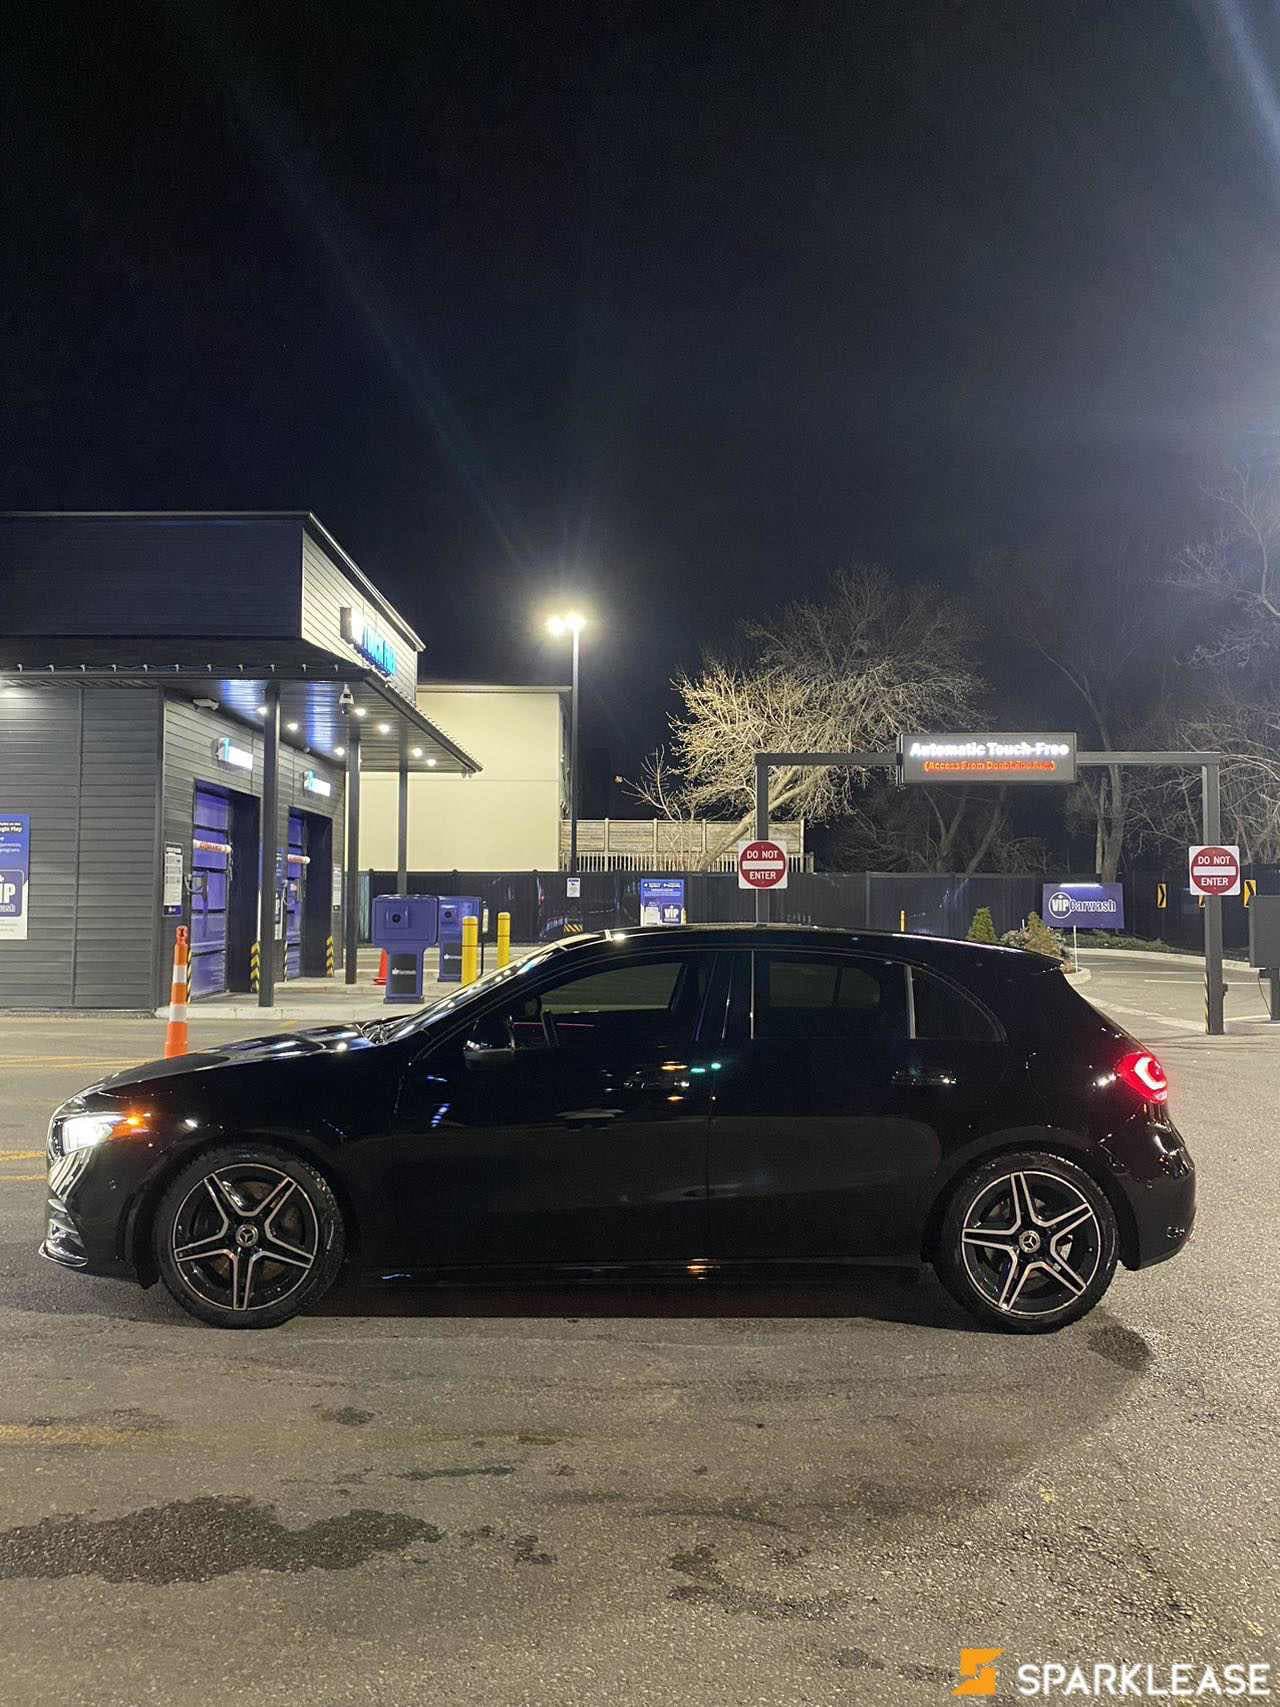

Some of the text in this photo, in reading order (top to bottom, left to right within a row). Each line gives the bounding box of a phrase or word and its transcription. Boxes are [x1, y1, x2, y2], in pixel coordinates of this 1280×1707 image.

[910, 742, 1069, 757] Automatic Touch-Free
[746, 850, 779, 859] DO NOT
[1197, 855, 1230, 865] DO NOT
[749, 871, 776, 880] ENTER
[1201, 877, 1229, 886] ENTER
[1051, 898, 1117, 913] VIP Carwash
[664, 908, 680, 918] VIP
